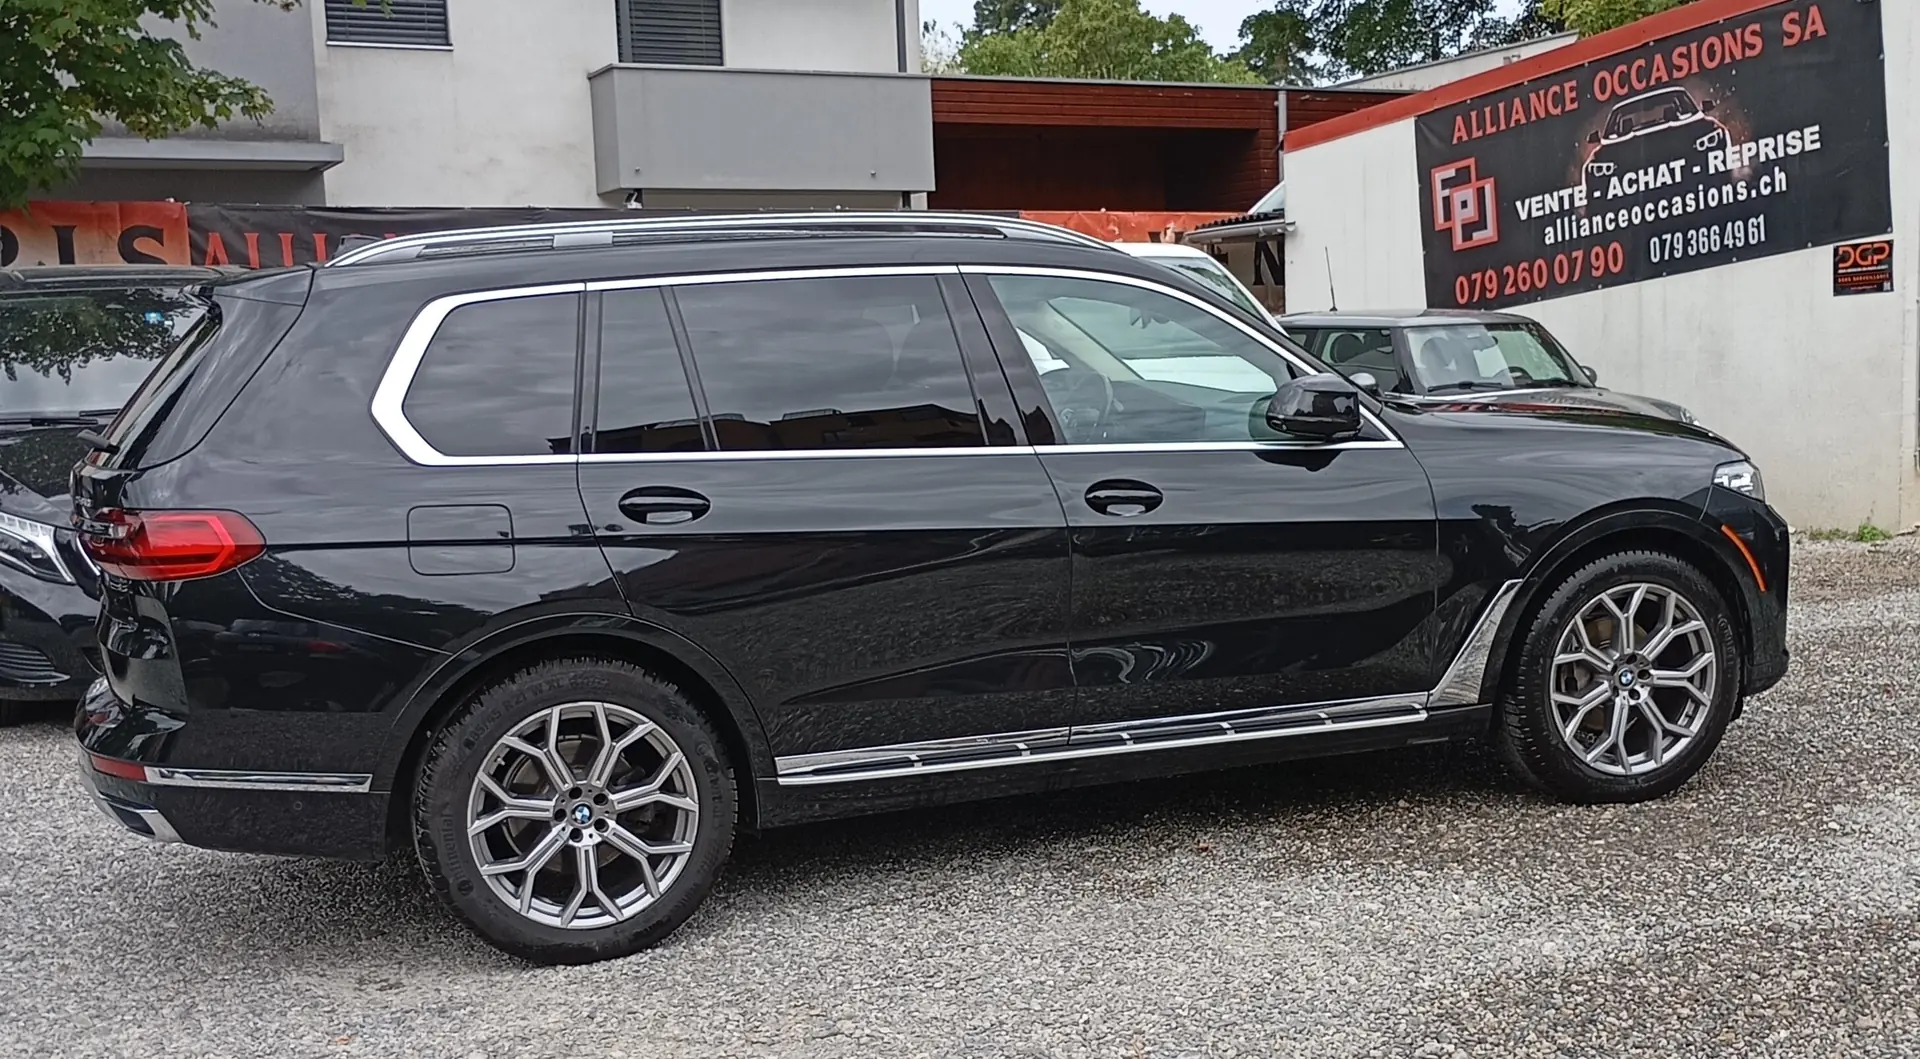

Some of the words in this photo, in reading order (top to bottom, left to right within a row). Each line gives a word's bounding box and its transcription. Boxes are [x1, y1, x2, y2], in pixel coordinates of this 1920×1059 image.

[1452, 79, 1579, 145] ALLIANCE
[1593, 23, 1763, 102] OCCASIONS
[1782, 4, 1827, 47] SA
[1515, 184, 1588, 221] VENTE
[1606, 159, 1686, 200] ACHAT
[1707, 124, 1822, 175] REPRISE
[1544, 165, 1788, 246] allianceoccasions.ch
[1455, 269, 1498, 305] 079
[1503, 258, 1548, 295] 260
[1553, 249, 1584, 284] 07
[1590, 240, 1624, 277] 90
[1650, 232, 1683, 263] 079
[1687, 224, 1721, 256] 366
[1723, 220, 1745, 249] 49
[1747, 213, 1766, 245] 61
[1838, 242, 1890, 268] DGP
